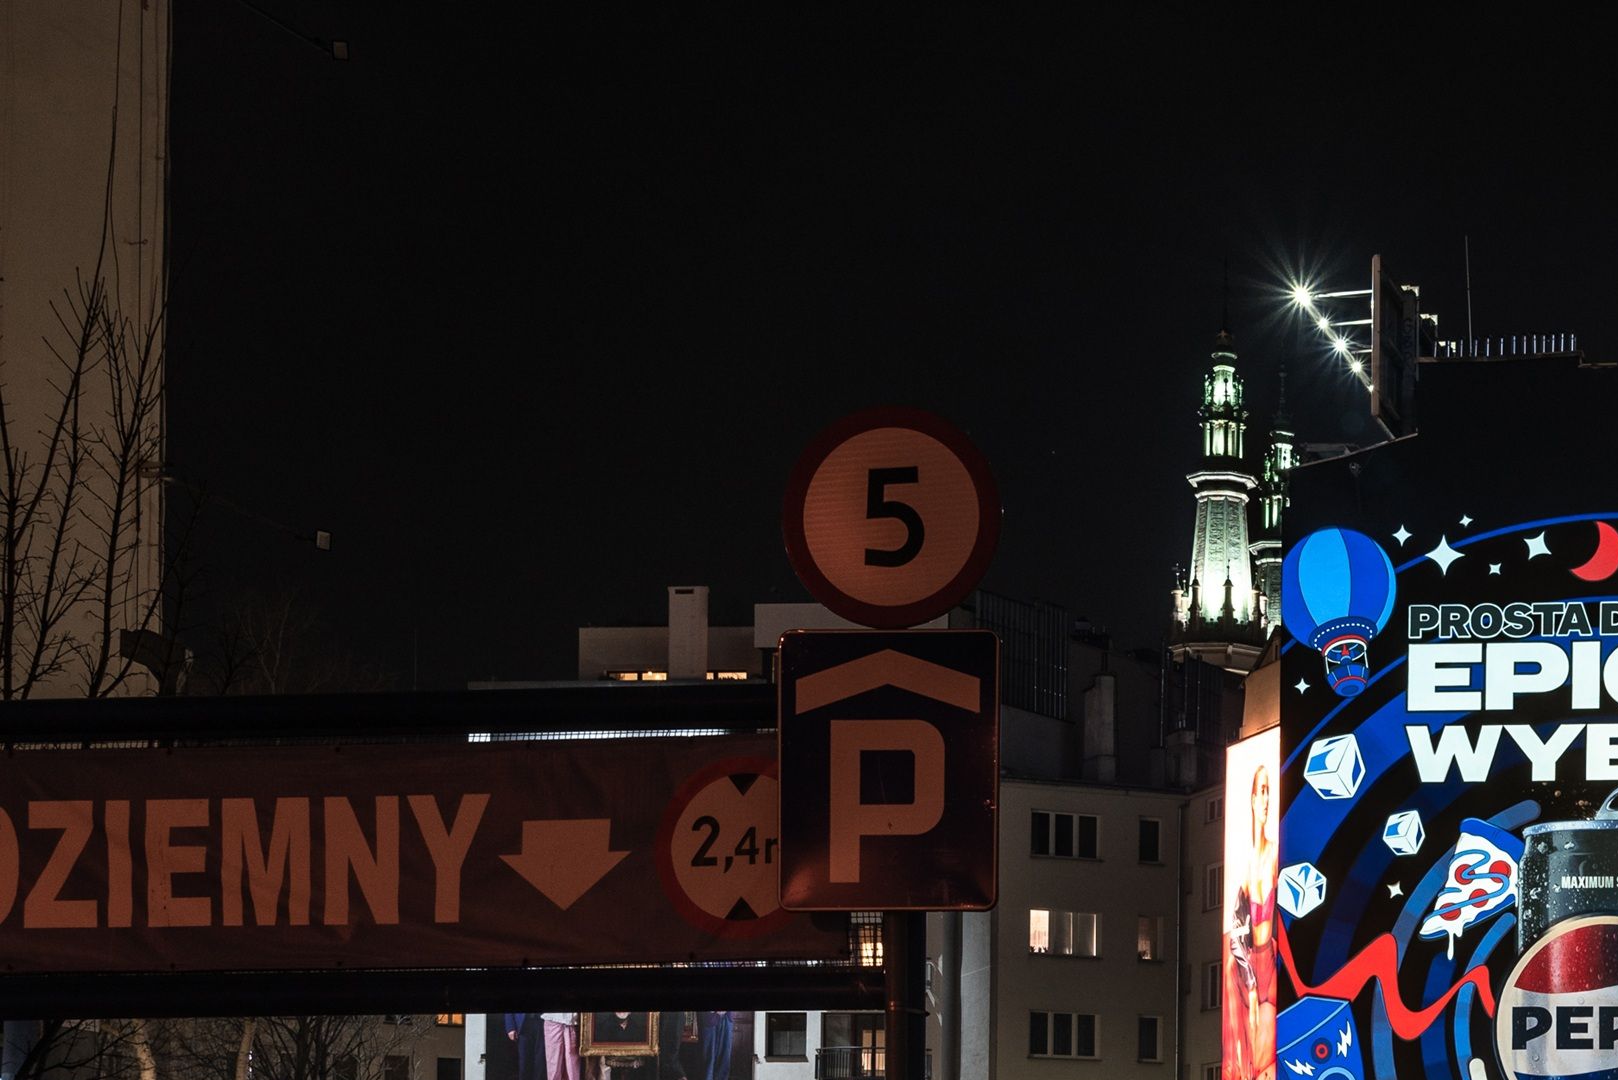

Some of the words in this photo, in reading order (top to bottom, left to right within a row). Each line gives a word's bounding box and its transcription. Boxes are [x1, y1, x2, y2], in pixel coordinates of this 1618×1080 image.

[864, 466, 925, 568] 5
[1408, 603, 1592, 639] PROSTA
[829, 719, 946, 884] P
[1561, 876, 1614, 889] MAXIMUM
